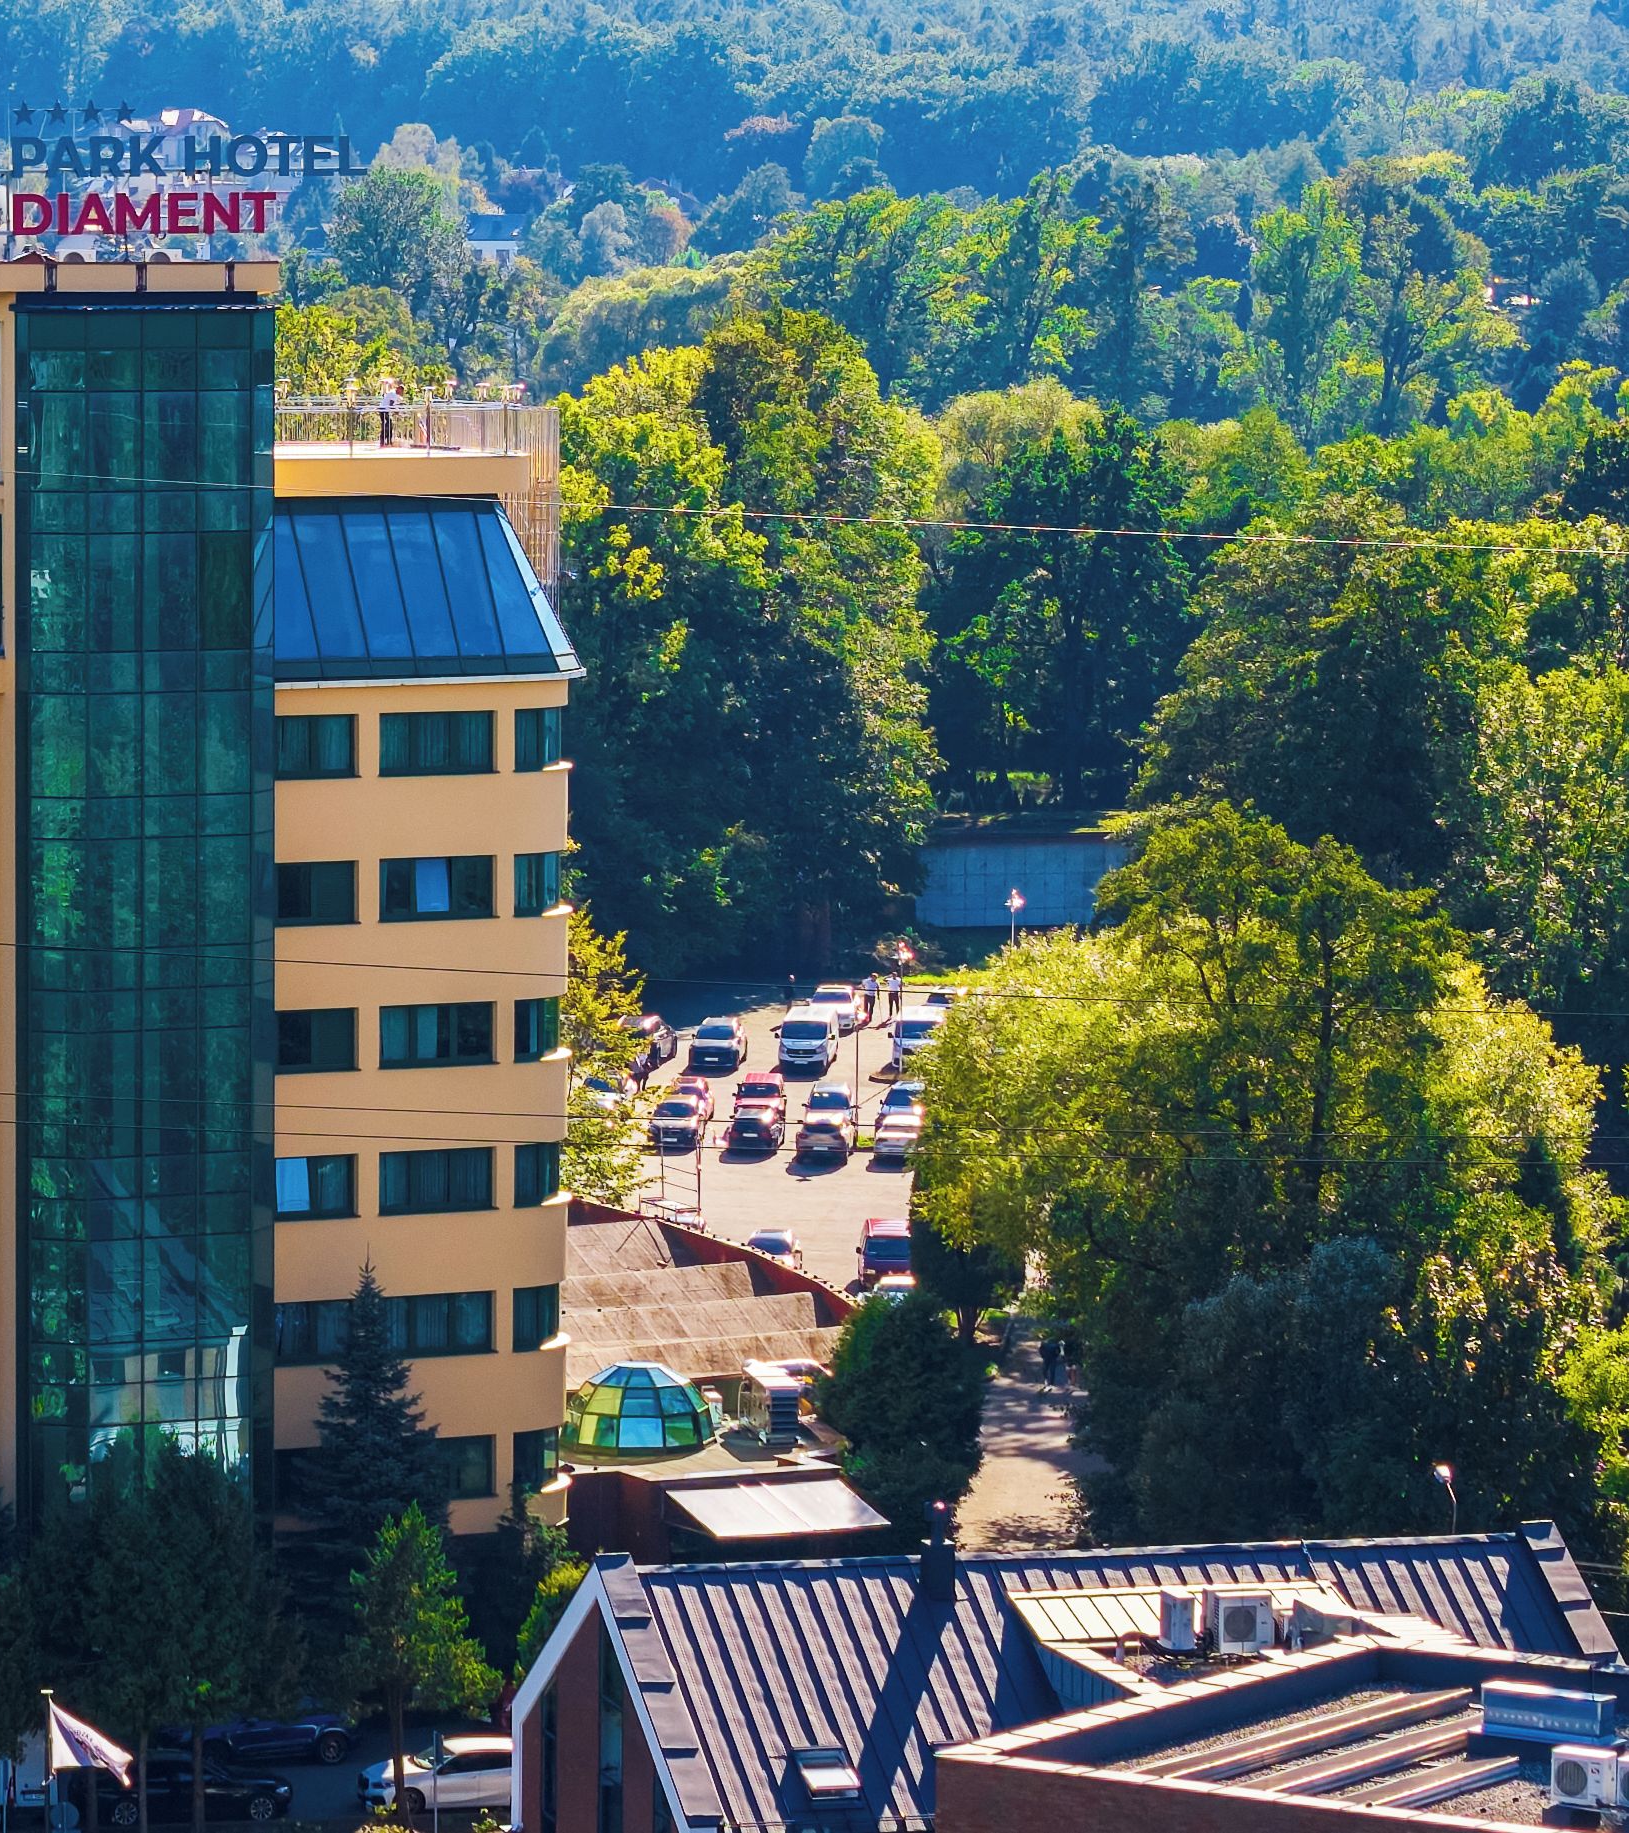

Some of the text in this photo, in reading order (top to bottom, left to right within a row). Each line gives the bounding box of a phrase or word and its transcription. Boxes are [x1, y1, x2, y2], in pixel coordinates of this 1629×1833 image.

[12, 134, 368, 178] PARK HOTEL
[12, 192, 277, 236] DIAMENT
